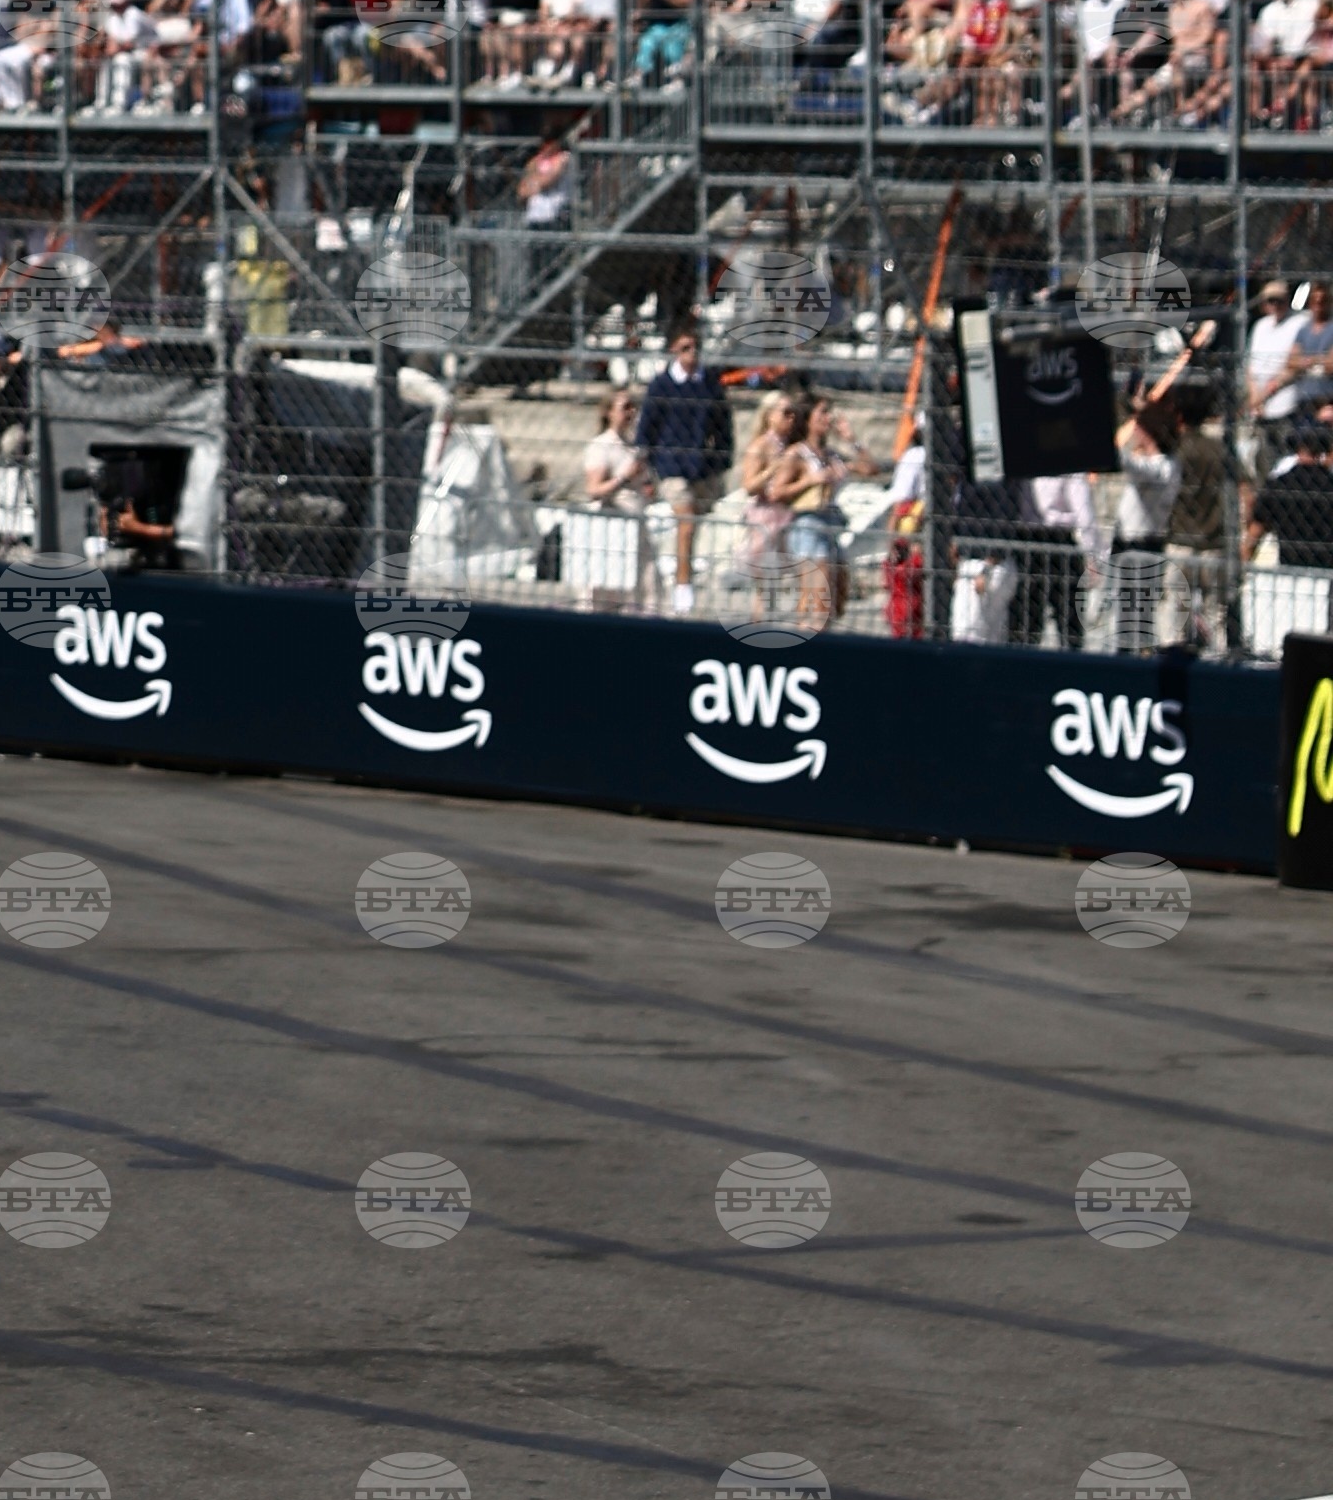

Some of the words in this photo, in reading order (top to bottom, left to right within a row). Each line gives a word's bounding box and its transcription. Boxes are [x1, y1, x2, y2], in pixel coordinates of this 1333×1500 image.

[53, 604, 167, 673] aws
[362, 632, 485, 702] aws
[690, 659, 821, 732] aws
[1052, 688, 1186, 765] aws
